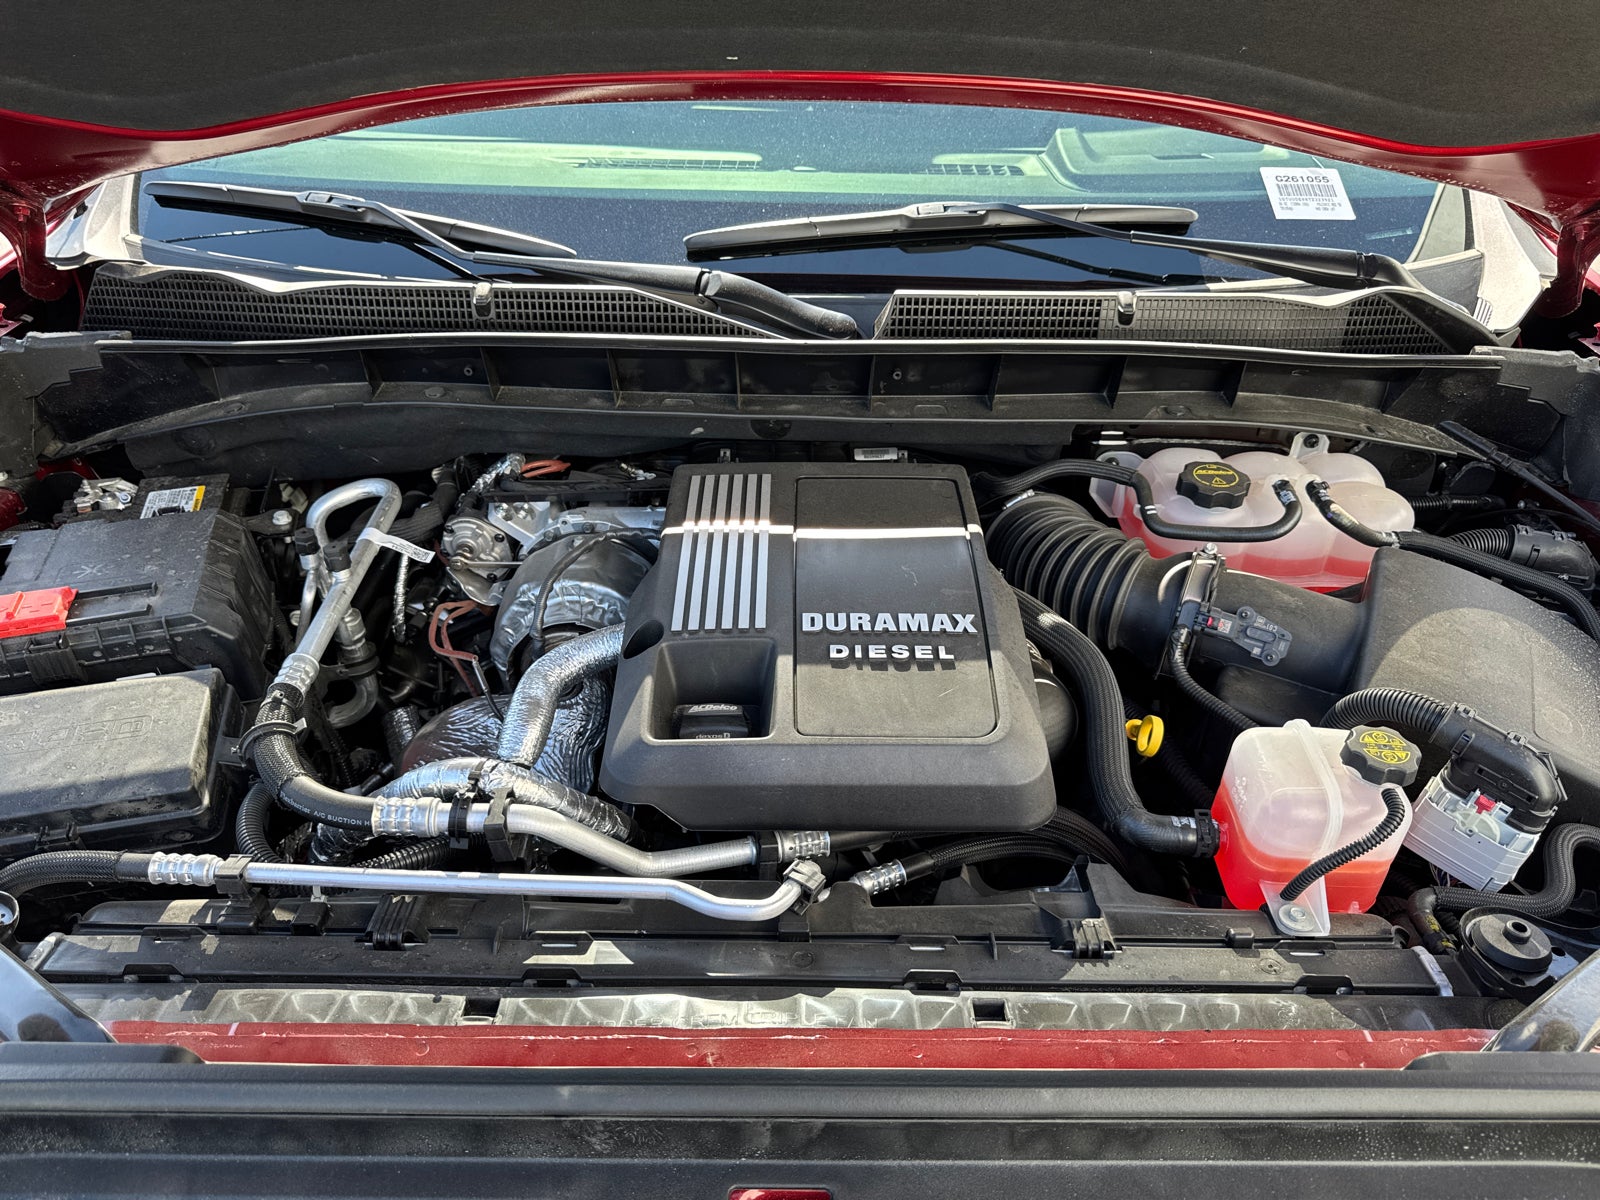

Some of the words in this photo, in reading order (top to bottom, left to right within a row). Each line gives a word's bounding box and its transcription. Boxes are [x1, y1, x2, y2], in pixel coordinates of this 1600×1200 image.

[1275, 175, 1330, 183] C261055
[802, 612, 978, 633] DURAMAX
[830, 644, 954, 660] DIESEL
[688, 704, 738, 713] ACDelco
[313, 810, 326, 819] A/C
[327, 814, 362, 826] SUCTION
